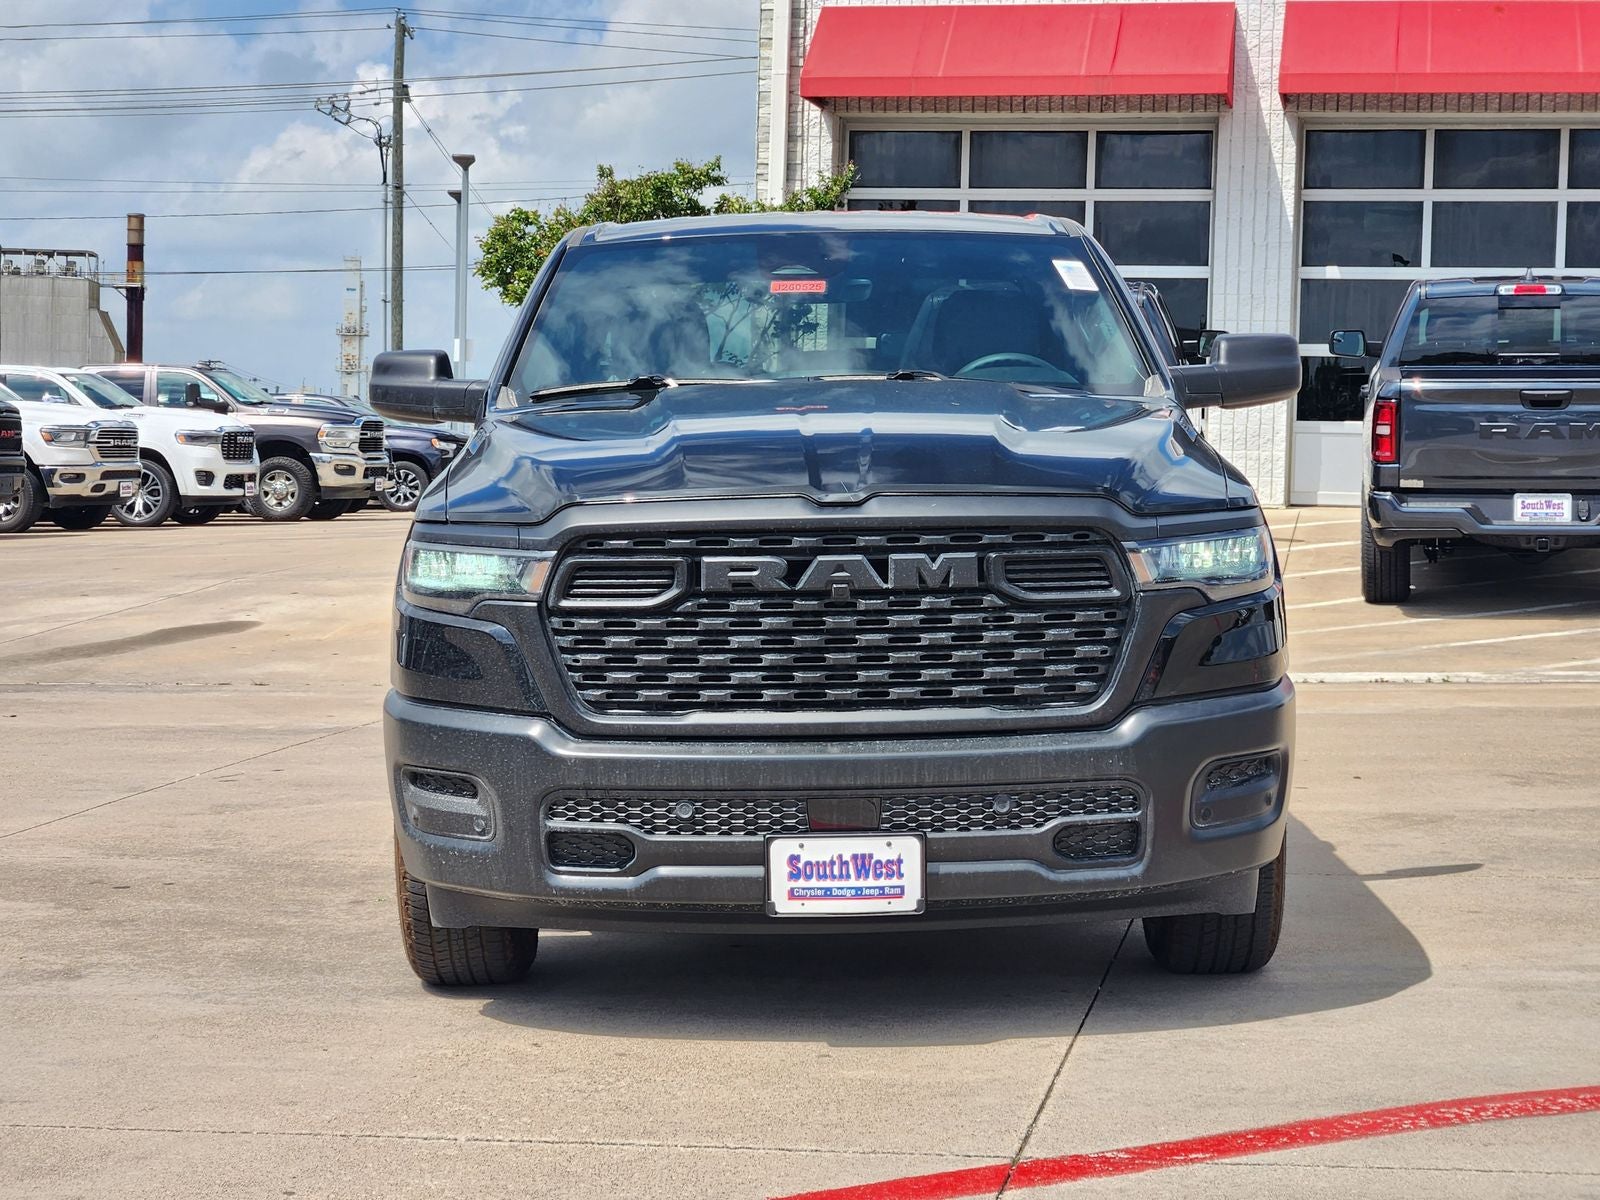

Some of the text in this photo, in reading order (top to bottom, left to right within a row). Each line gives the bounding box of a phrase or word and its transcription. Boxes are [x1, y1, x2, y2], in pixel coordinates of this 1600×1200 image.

[774, 283, 822, 291] J260525
[0, 430, 16, 438] AM
[1480, 422, 1600, 440] RAM
[1520, 500, 1564, 511] SouthWest
[701, 553, 978, 591] RAM
[787, 853, 905, 882] SouthWest
[793, 886, 901, 898] Chrysler Dodge Jeep Ram
